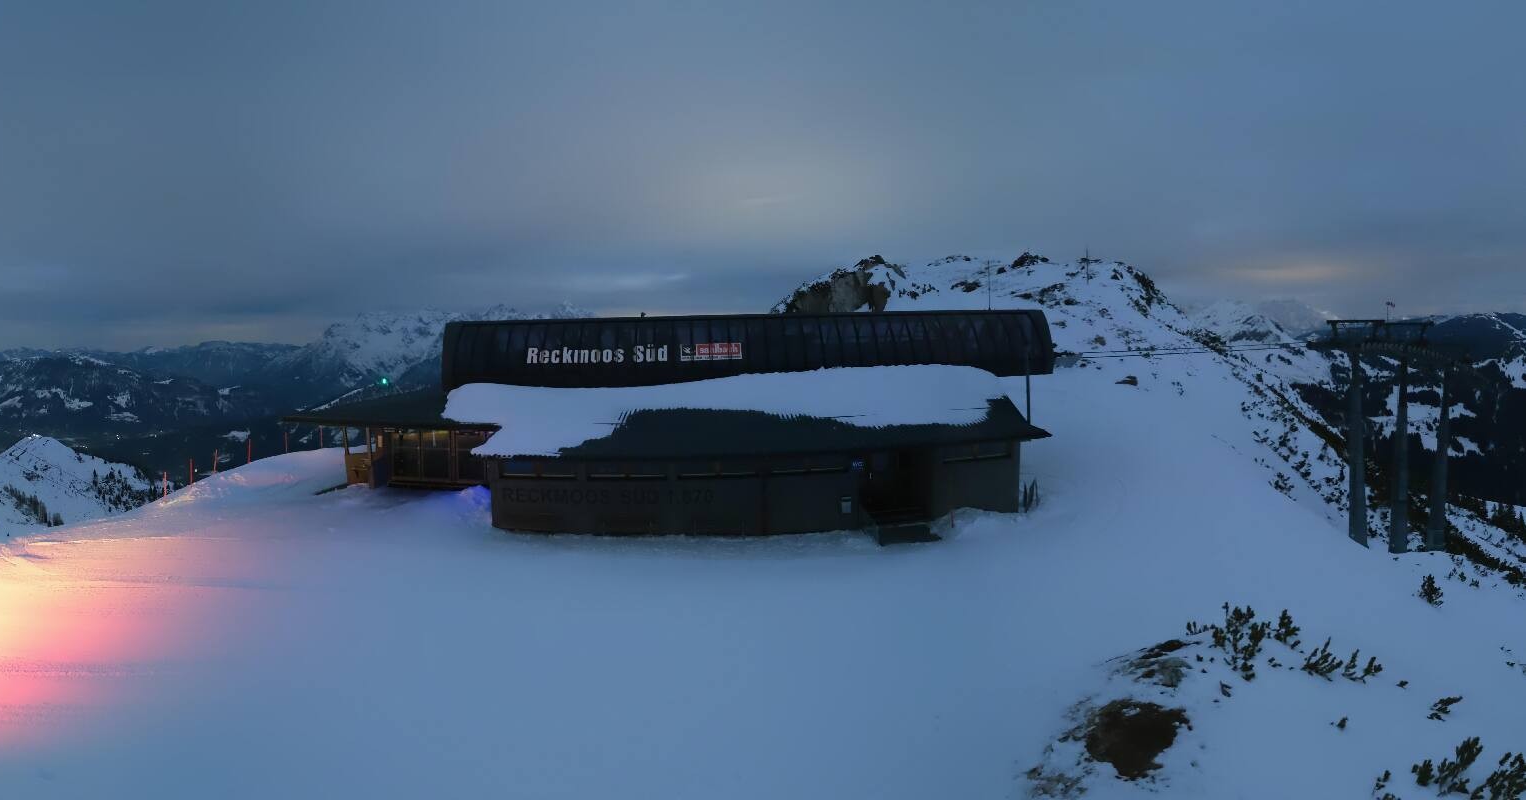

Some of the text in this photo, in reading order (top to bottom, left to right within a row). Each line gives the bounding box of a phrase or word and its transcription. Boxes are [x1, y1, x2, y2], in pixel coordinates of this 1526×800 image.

[526, 344, 668, 364] Reckmoos Süd
[502, 487, 611, 504] RECKMOOS
